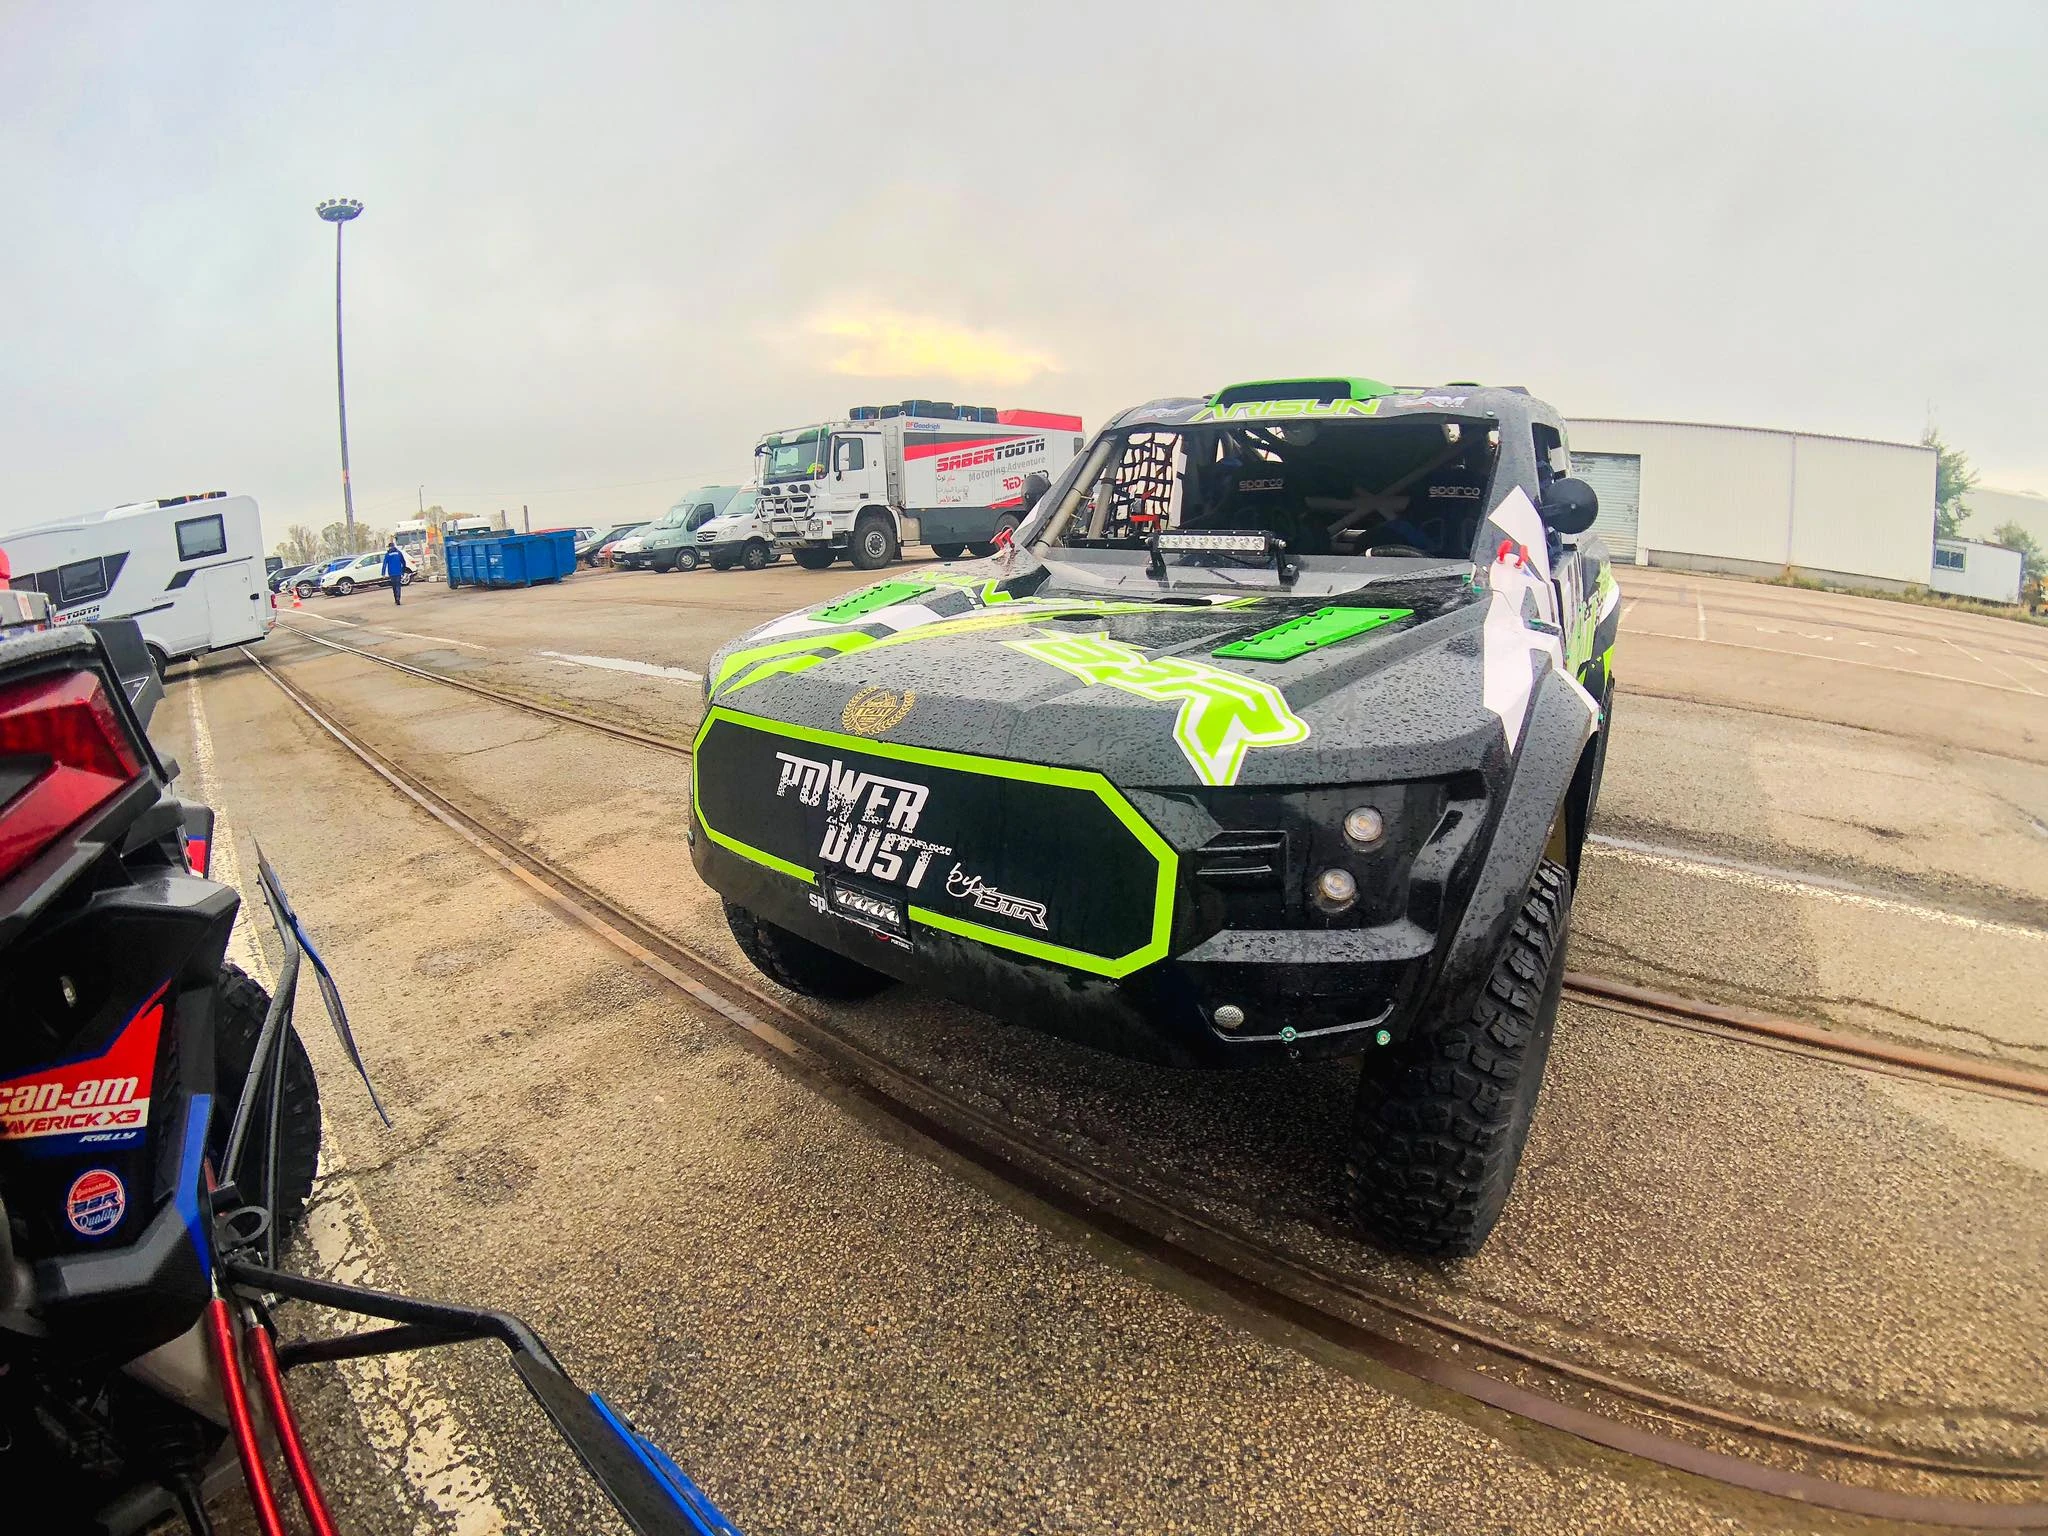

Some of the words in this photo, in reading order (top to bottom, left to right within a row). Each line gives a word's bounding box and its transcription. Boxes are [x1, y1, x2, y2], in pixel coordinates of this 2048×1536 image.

[1187, 398, 1380, 422] ARISUN
[935, 438, 1045, 472] SABERTOOTH
[968, 465, 1005, 482] Motoring
[1007, 456, 1046, 472] Adventure
[1239, 478, 1283, 490] sparco
[1429, 486, 1480, 496] sparco
[776, 751, 930, 834] POWER
[818, 820, 952, 889] DUST
[946, 862, 982, 898] by
[974, 890, 1049, 931] BTR
[102, 1109, 141, 1125] X3
[79, 1131, 138, 1143] RALLY
[80, 1208, 118, 1230] Quality
